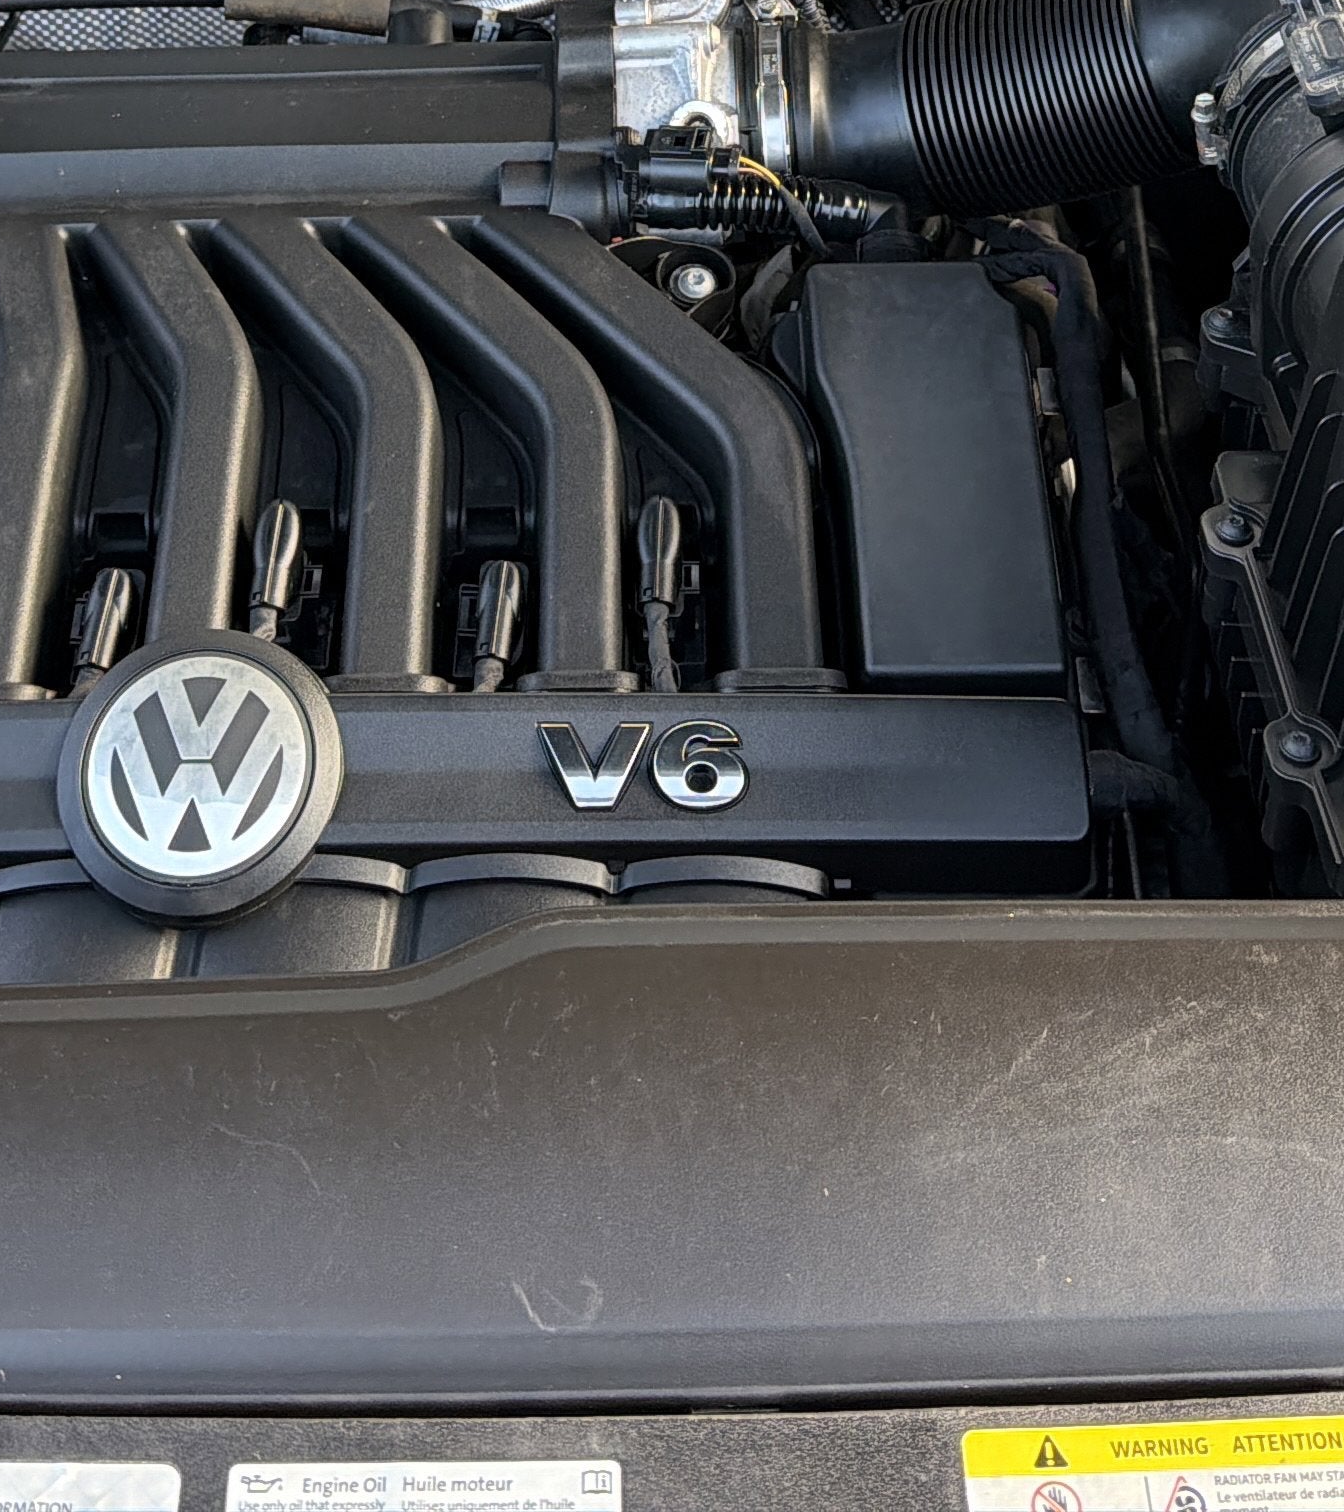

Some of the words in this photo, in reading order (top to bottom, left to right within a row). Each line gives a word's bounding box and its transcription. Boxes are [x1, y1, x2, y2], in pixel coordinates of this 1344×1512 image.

[536, 719, 751, 812] V6
[1110, 1437, 1209, 1458] WARNING
[1233, 1431, 1344, 1454] ATTENTION
[303, 1477, 359, 1497] Engine
[364, 1476, 387, 1493] Oil
[403, 1476, 446, 1492] Huile
[451, 1477, 513, 1492] moteur
[1214, 1473, 1273, 1486] RADIATOR
[1274, 1472, 1297, 1484] FAN
[1300, 1470, 1324, 1483] MAY
[1217, 1490, 1231, 1504] Le
[1233, 1487, 1297, 1503] ventilateur
[1300, 1486, 1314, 1500] de
[238, 1501, 258, 1511] Use
[261, 1500, 287, 1512] only
[290, 1500, 303, 1511] oil
[305, 1500, 329, 1510] that
[332, 1499, 386, 1512] expressly
[402, 1499, 445, 1512] Utilisez
[447, 1500, 520, 1512] uniquement
[523, 1499, 538, 1510] de
